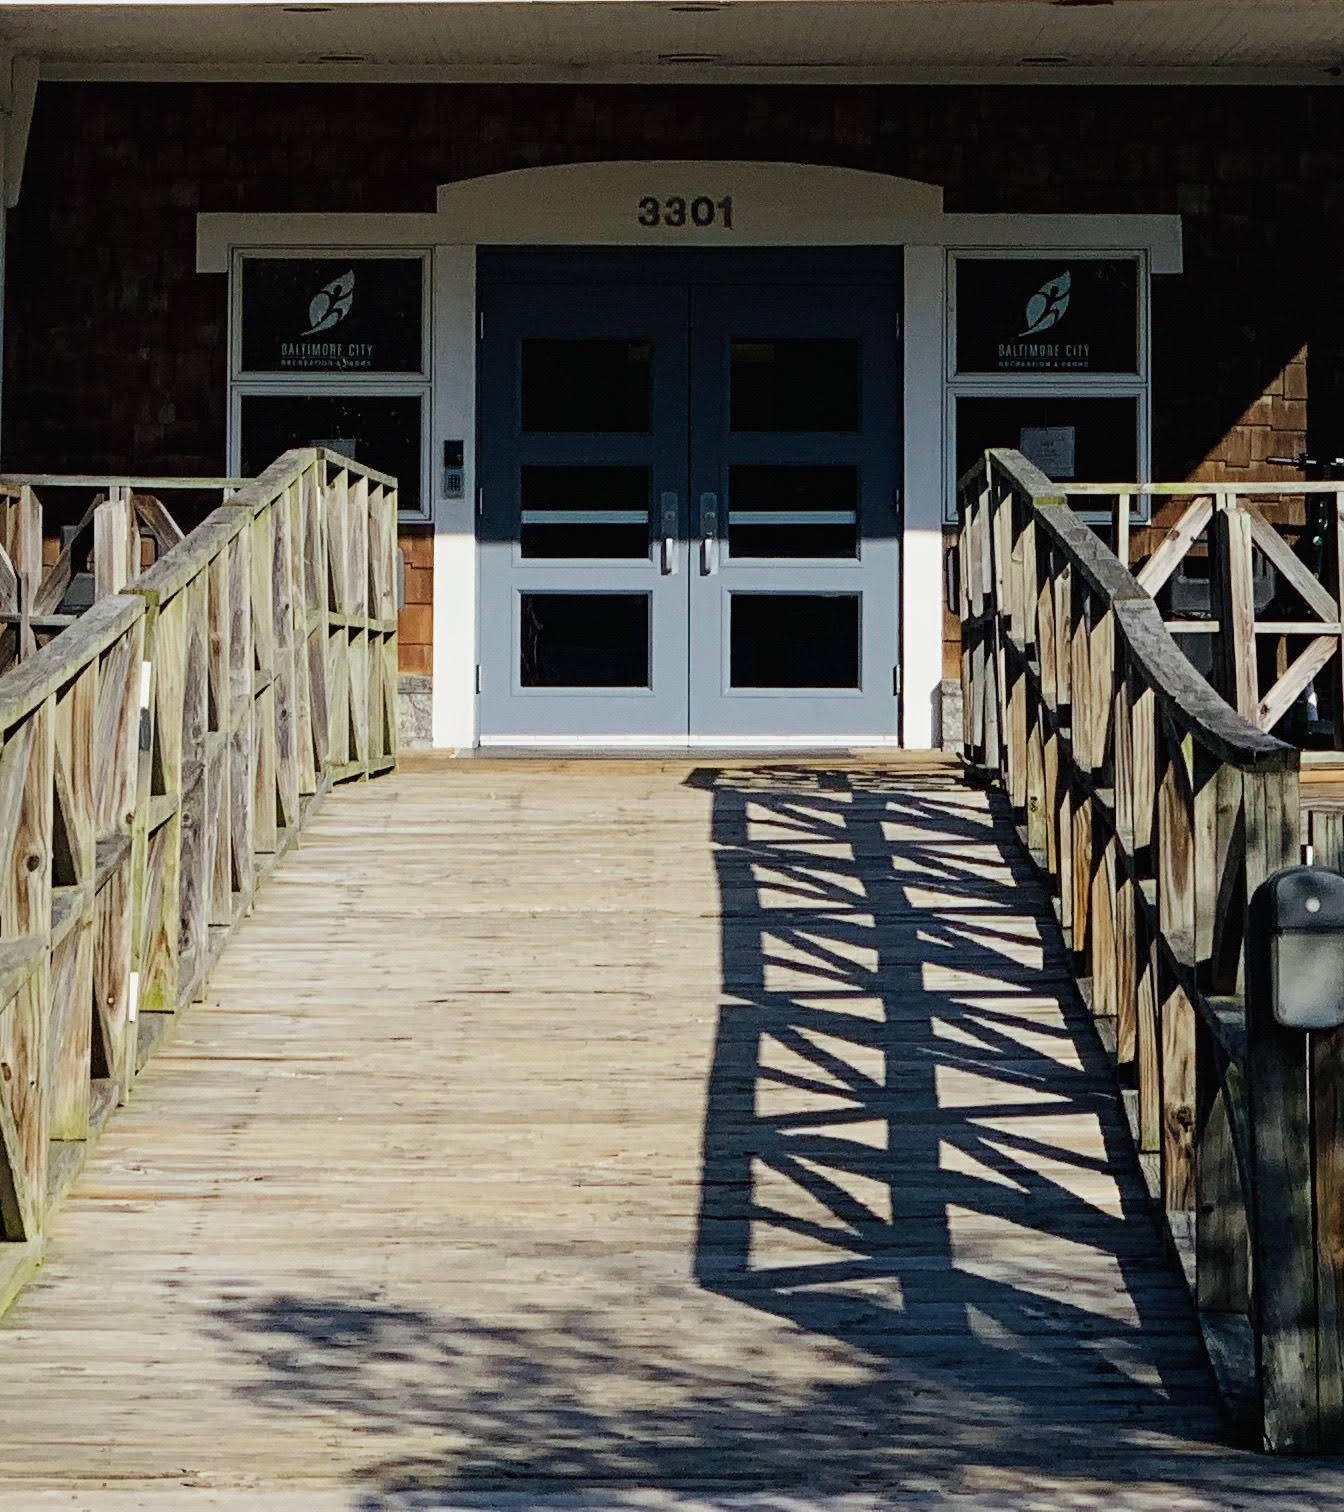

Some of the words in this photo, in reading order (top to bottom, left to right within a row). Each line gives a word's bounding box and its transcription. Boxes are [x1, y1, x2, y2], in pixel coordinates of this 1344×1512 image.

[638, 195, 733, 229] 3301
[348, 343, 373, 357] CITY
[998, 343, 1060, 357] BALTIMORE
[1065, 343, 1090, 357] CITY
